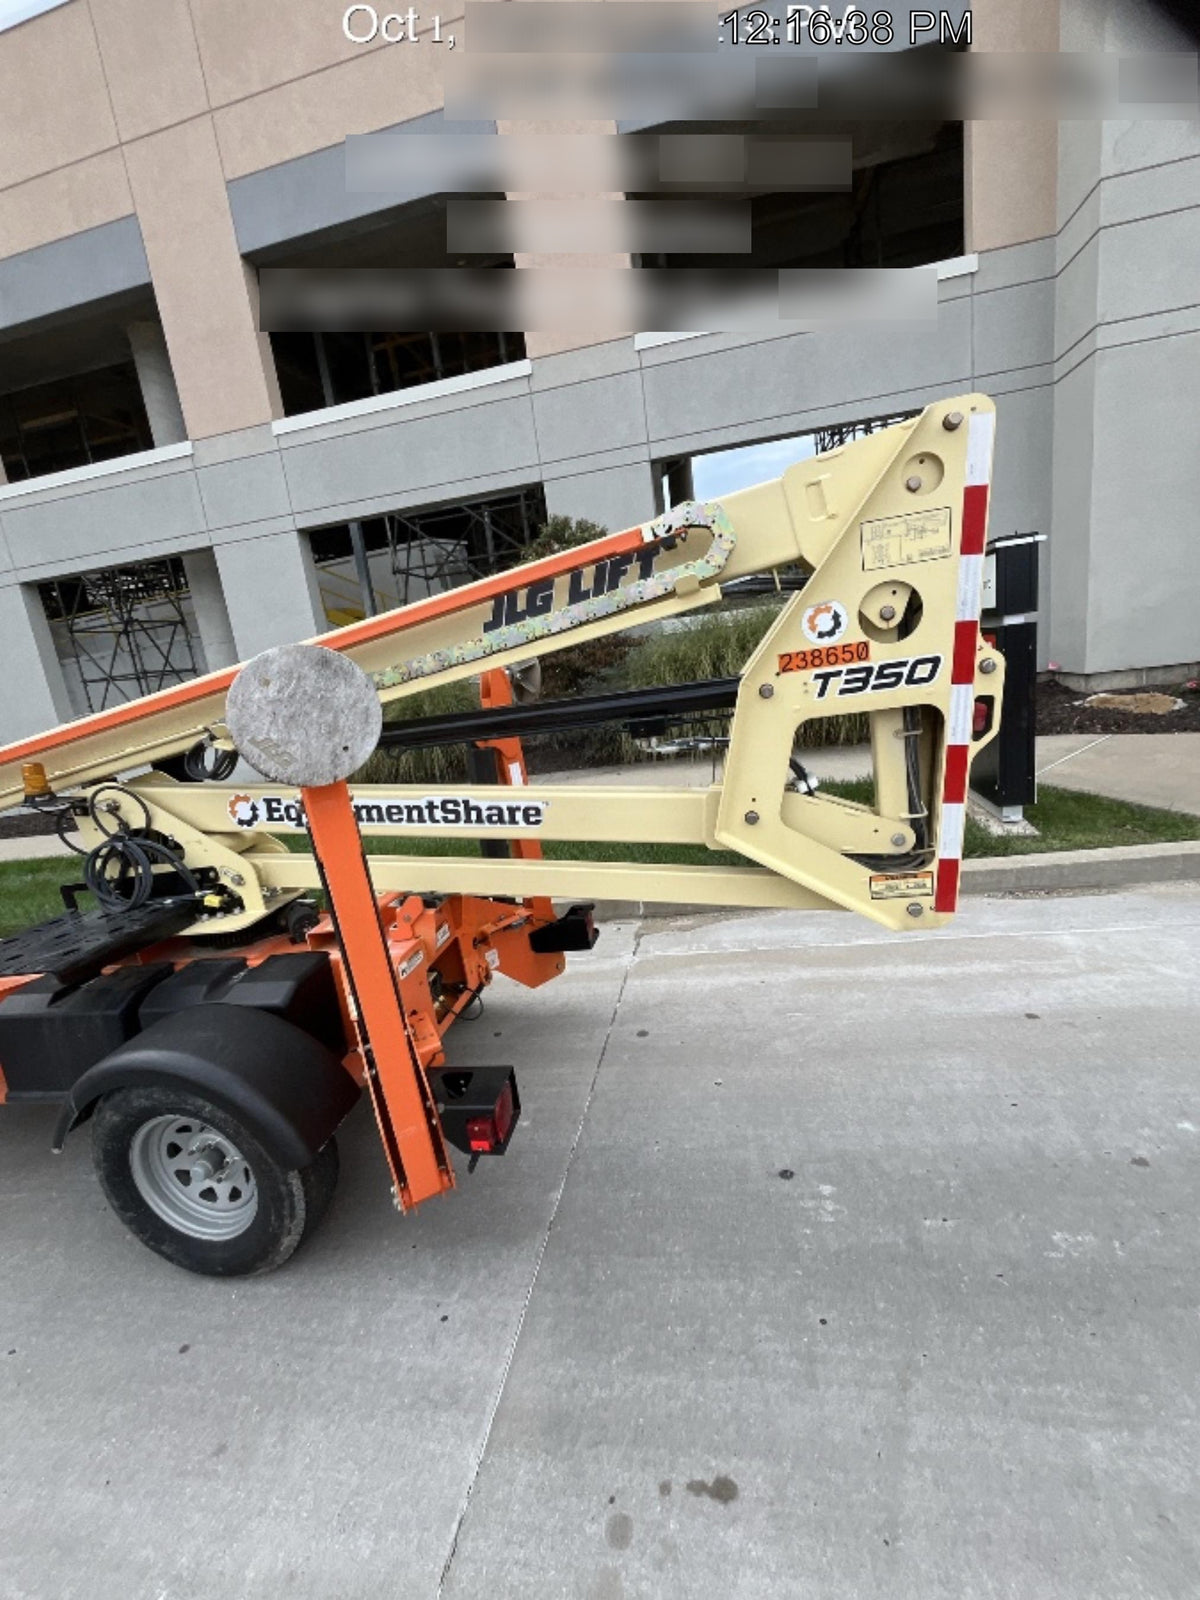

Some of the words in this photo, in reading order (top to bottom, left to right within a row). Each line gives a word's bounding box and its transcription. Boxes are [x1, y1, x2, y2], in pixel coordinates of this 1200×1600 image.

[484, 578, 554, 633] JLG
[779, 641, 870, 673] 238650
[812, 655, 943, 699] T350
